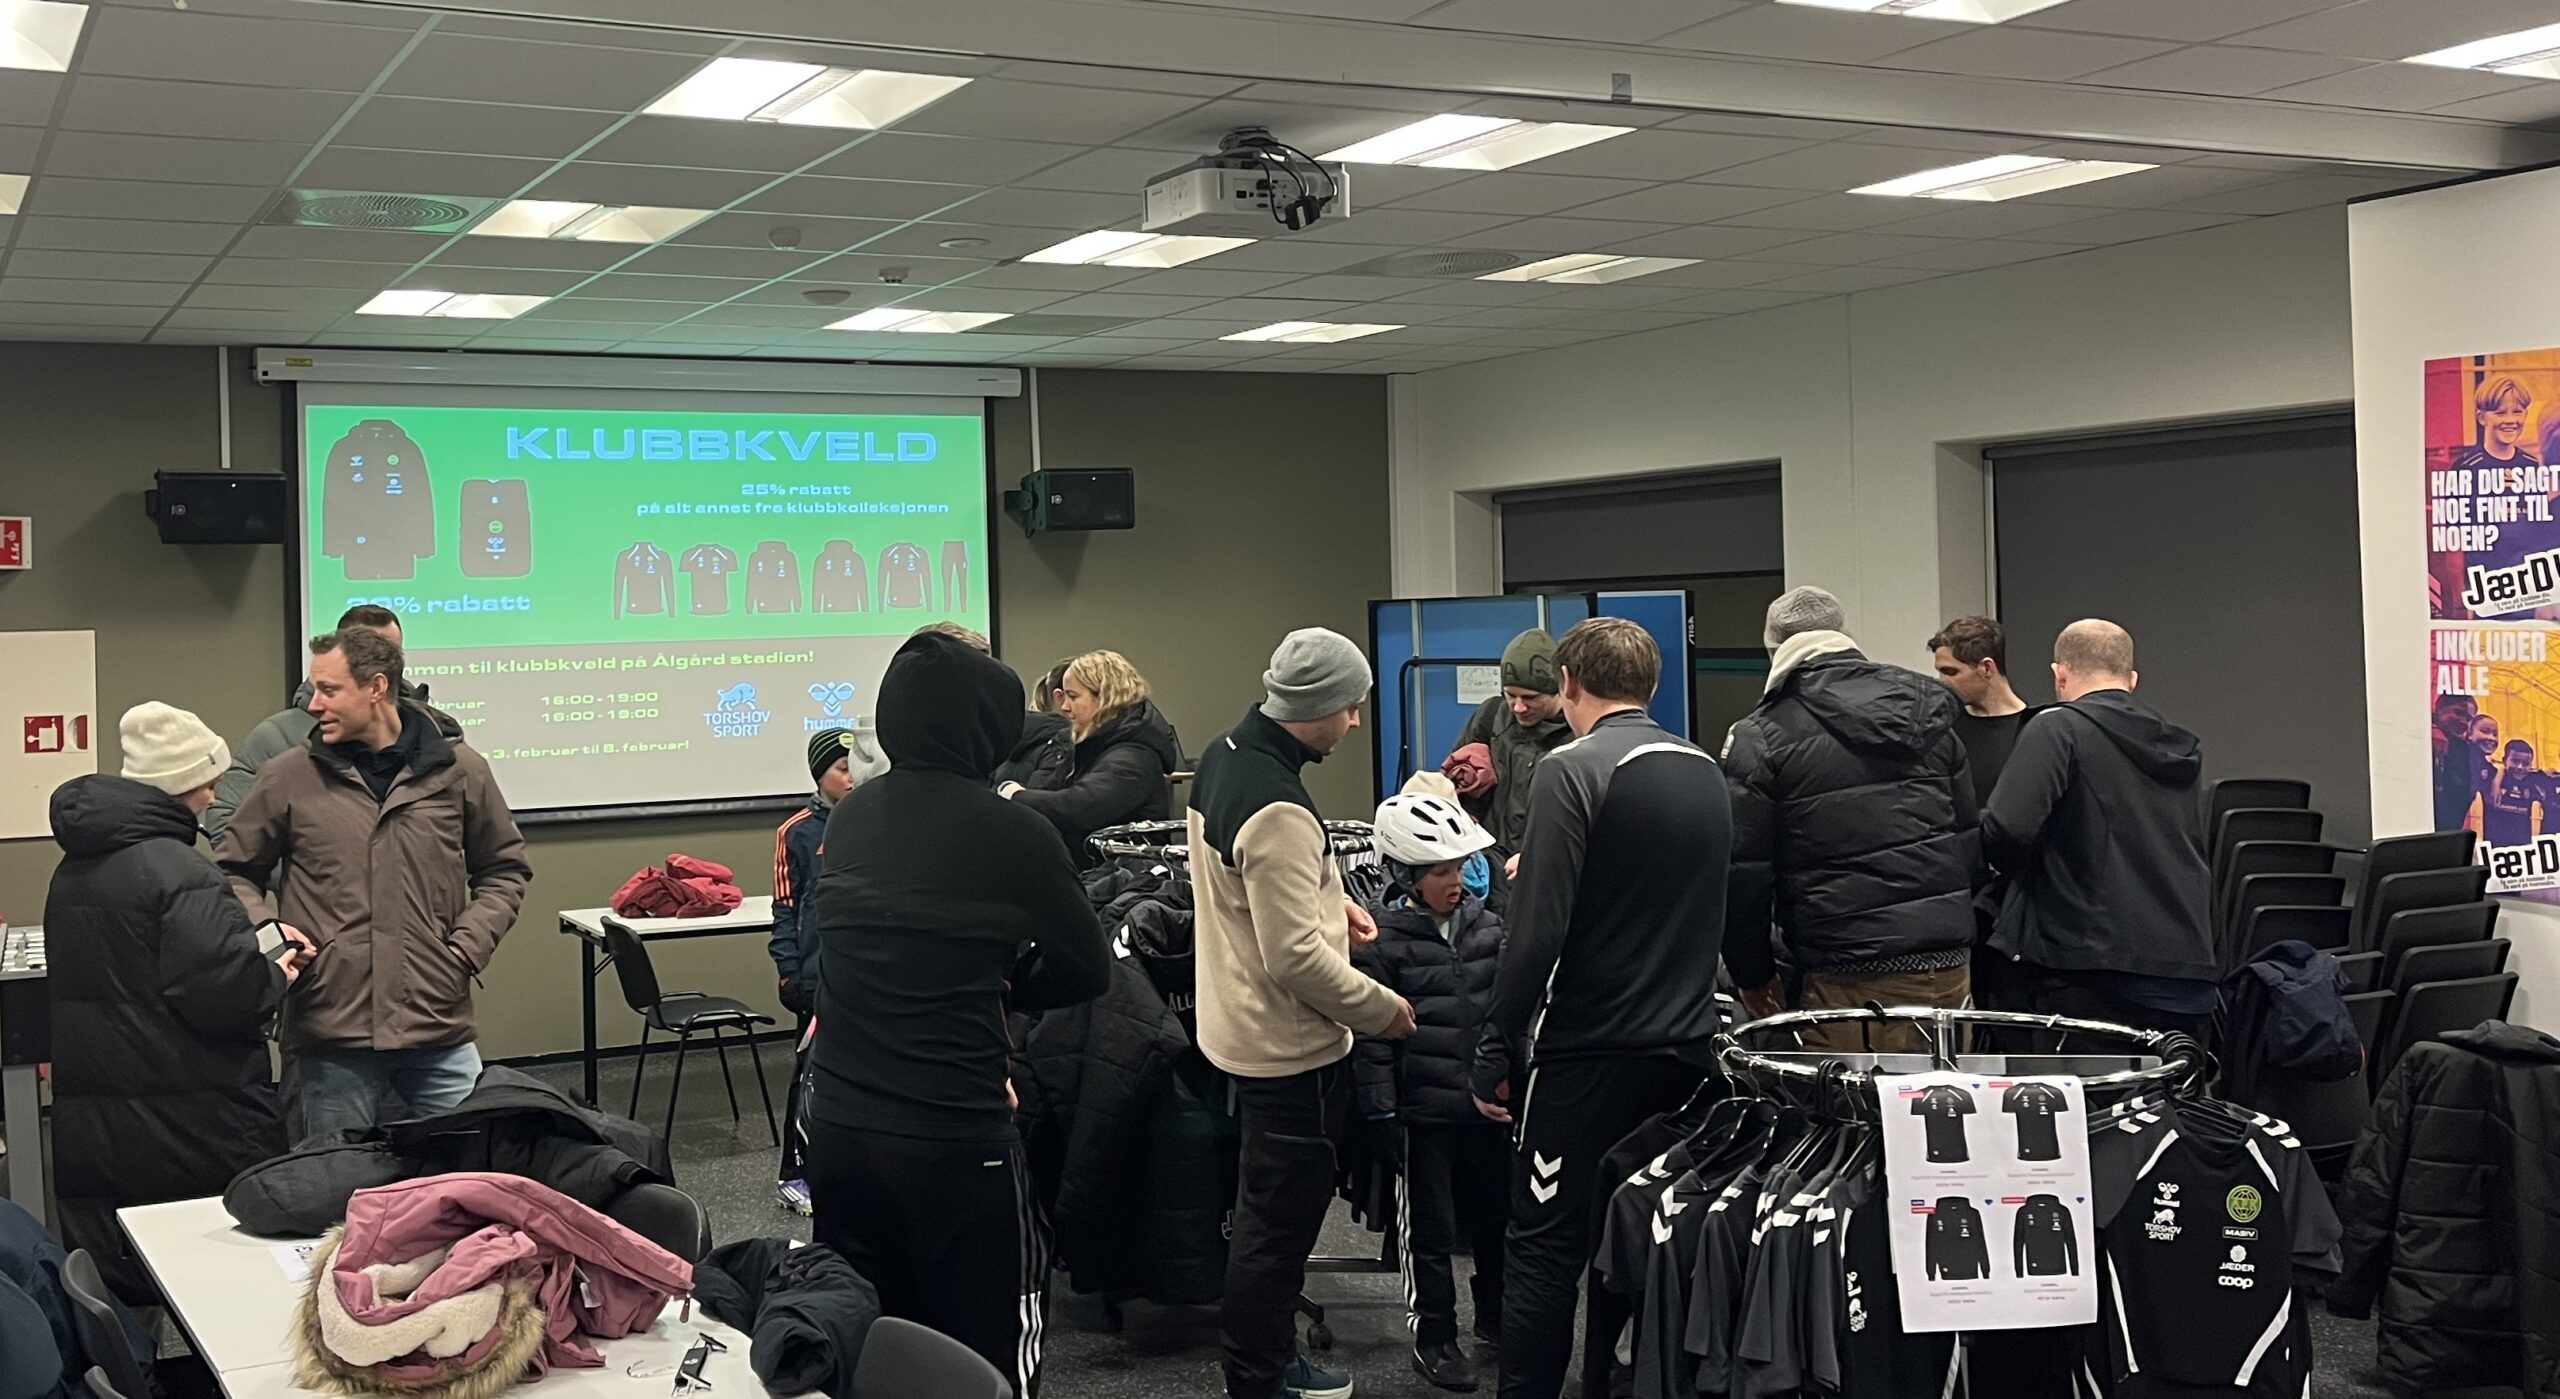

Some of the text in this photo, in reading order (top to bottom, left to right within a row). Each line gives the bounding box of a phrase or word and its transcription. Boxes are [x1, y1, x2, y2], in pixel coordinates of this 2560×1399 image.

[506, 427, 938, 462] KLUBBKVELD
[741, 483, 852, 496] 25% rabatt
[2431, 464, 2560, 497] HAR DU SAGT
[637, 501, 949, 517] på alt annet fra klubbkolleksjonen
[2431, 494, 2554, 525] NOE FINT TIL
[2432, 524, 2500, 552] NOEN?
[2466, 553, 2560, 606] JærD
[427, 594, 531, 613] rabatt
[2435, 630, 2547, 662] INKLUDER
[468, 660, 492, 674] til
[497, 656, 616, 674] klubbkveld
[621, 655, 648, 672] på
[730, 650, 815, 665] stadion!
[2436, 664, 2490, 697] ALLE
[703, 710, 771, 726] TORSHOV
[713, 723, 760, 738] SPORT
[514, 744, 579, 759] februar
[583, 744, 600, 755] til
[2144, 1222, 2182, 1235] TORSHOV
[2148, 1231, 2176, 1241] SPORT
[2217, 1275, 2254, 1290] coop
